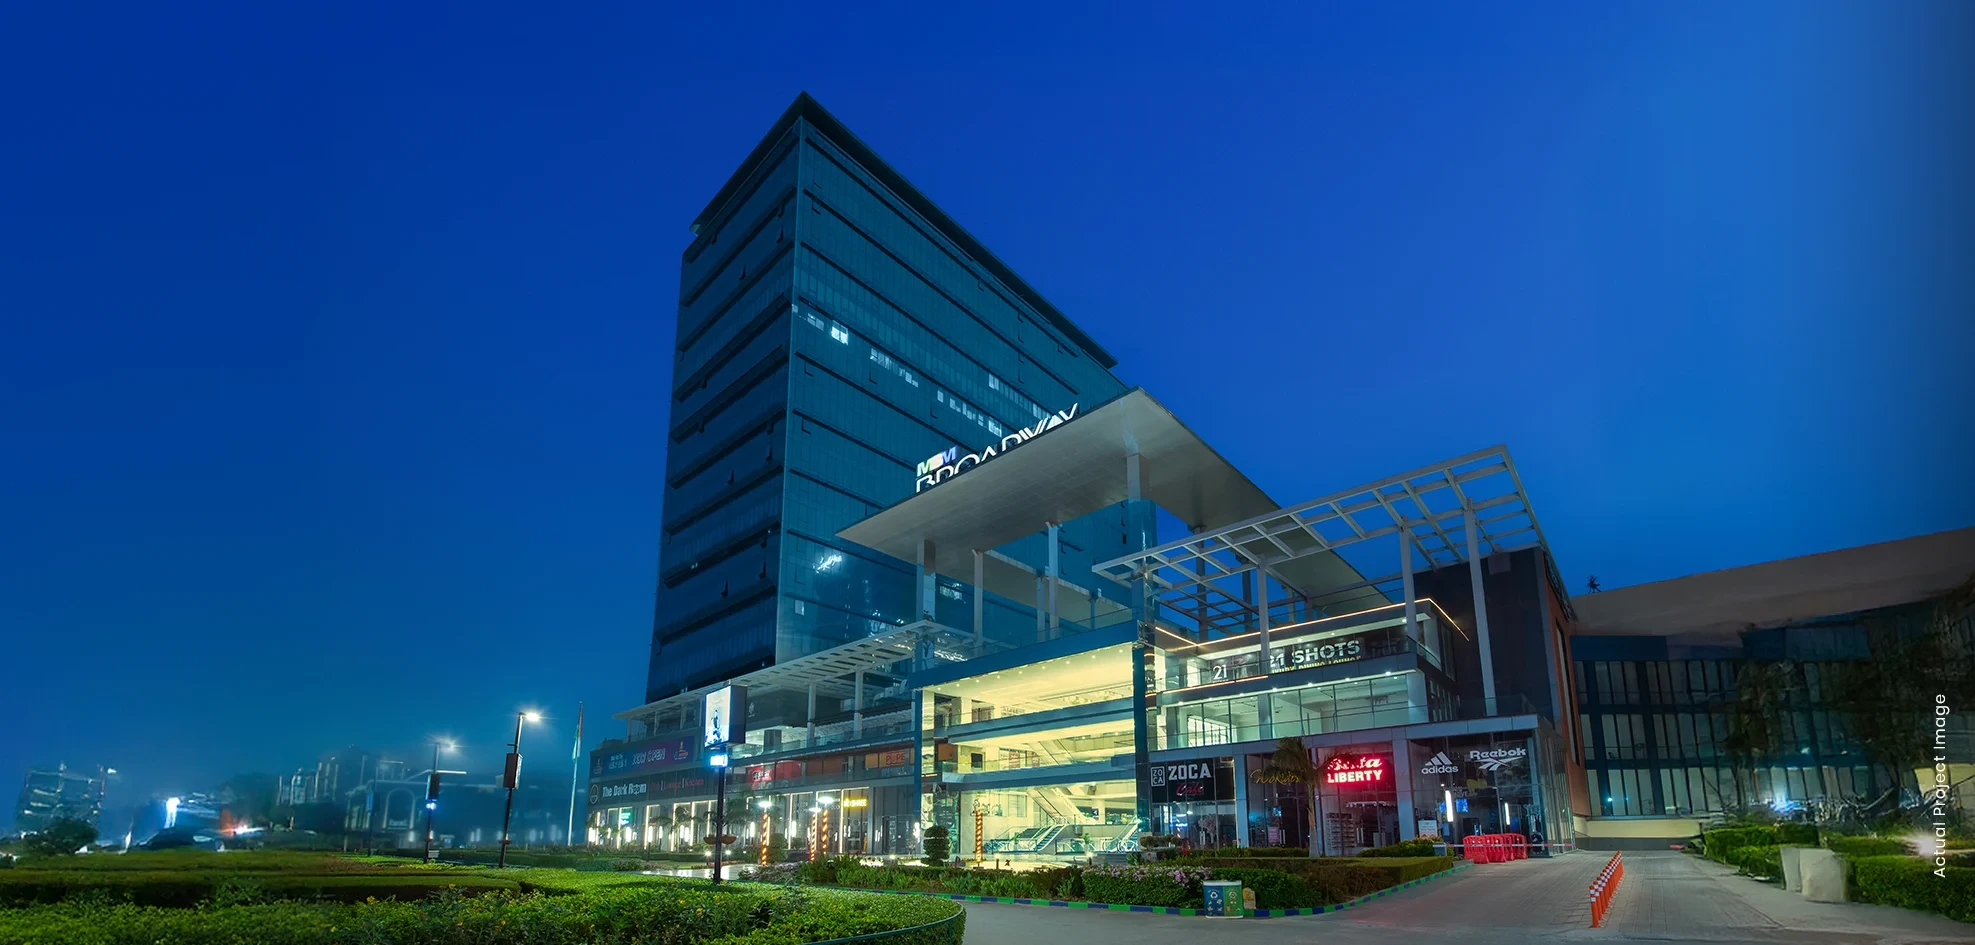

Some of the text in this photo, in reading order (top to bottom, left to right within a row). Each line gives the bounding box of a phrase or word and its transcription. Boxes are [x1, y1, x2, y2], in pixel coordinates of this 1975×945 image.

[917, 446, 957, 477] MM
[1291, 640, 1361, 664] SHOTS
[1212, 664, 1227, 680] 21
[1469, 748, 1526, 760] Reebok
[1167, 763, 1212, 781] ZOCA
[1327, 769, 1382, 783] LIBERTY
[1421, 765, 1459, 775] adidas
[602, 783, 647, 798] The Dark Room
